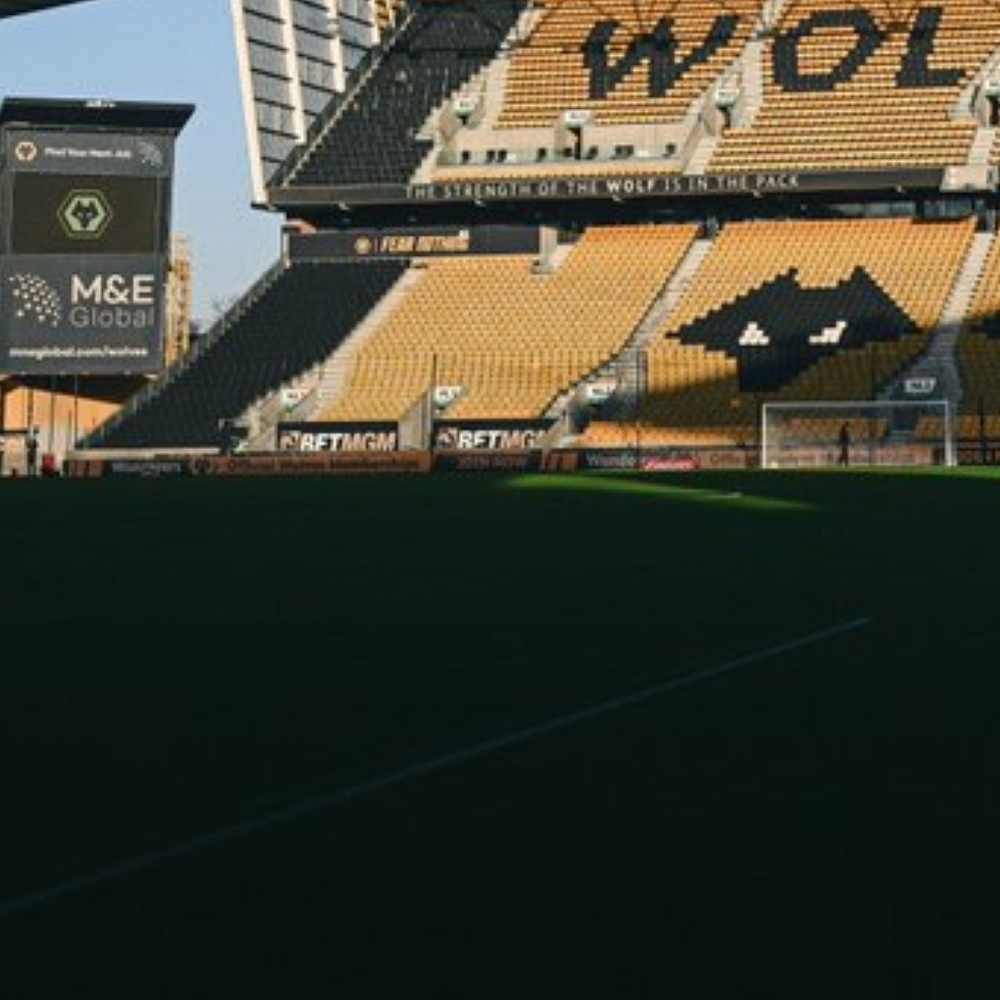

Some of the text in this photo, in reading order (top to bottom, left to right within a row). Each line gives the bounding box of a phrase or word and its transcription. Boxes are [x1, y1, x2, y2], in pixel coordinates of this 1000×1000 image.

[444, 181, 532, 198] STRENGTH
[539, 181, 557, 196] OF
[568, 180, 597, 195] THE
[606, 179, 656, 193] WOLF
[664, 178, 682, 192] IS
[689, 177, 708, 191] IN
[716, 176, 748, 190] THE
[756, 174, 799, 188] PACK
[71, 274, 155, 305] M&E
[69, 307, 155, 328] Global
[299, 432, 396, 451] BETMGM
